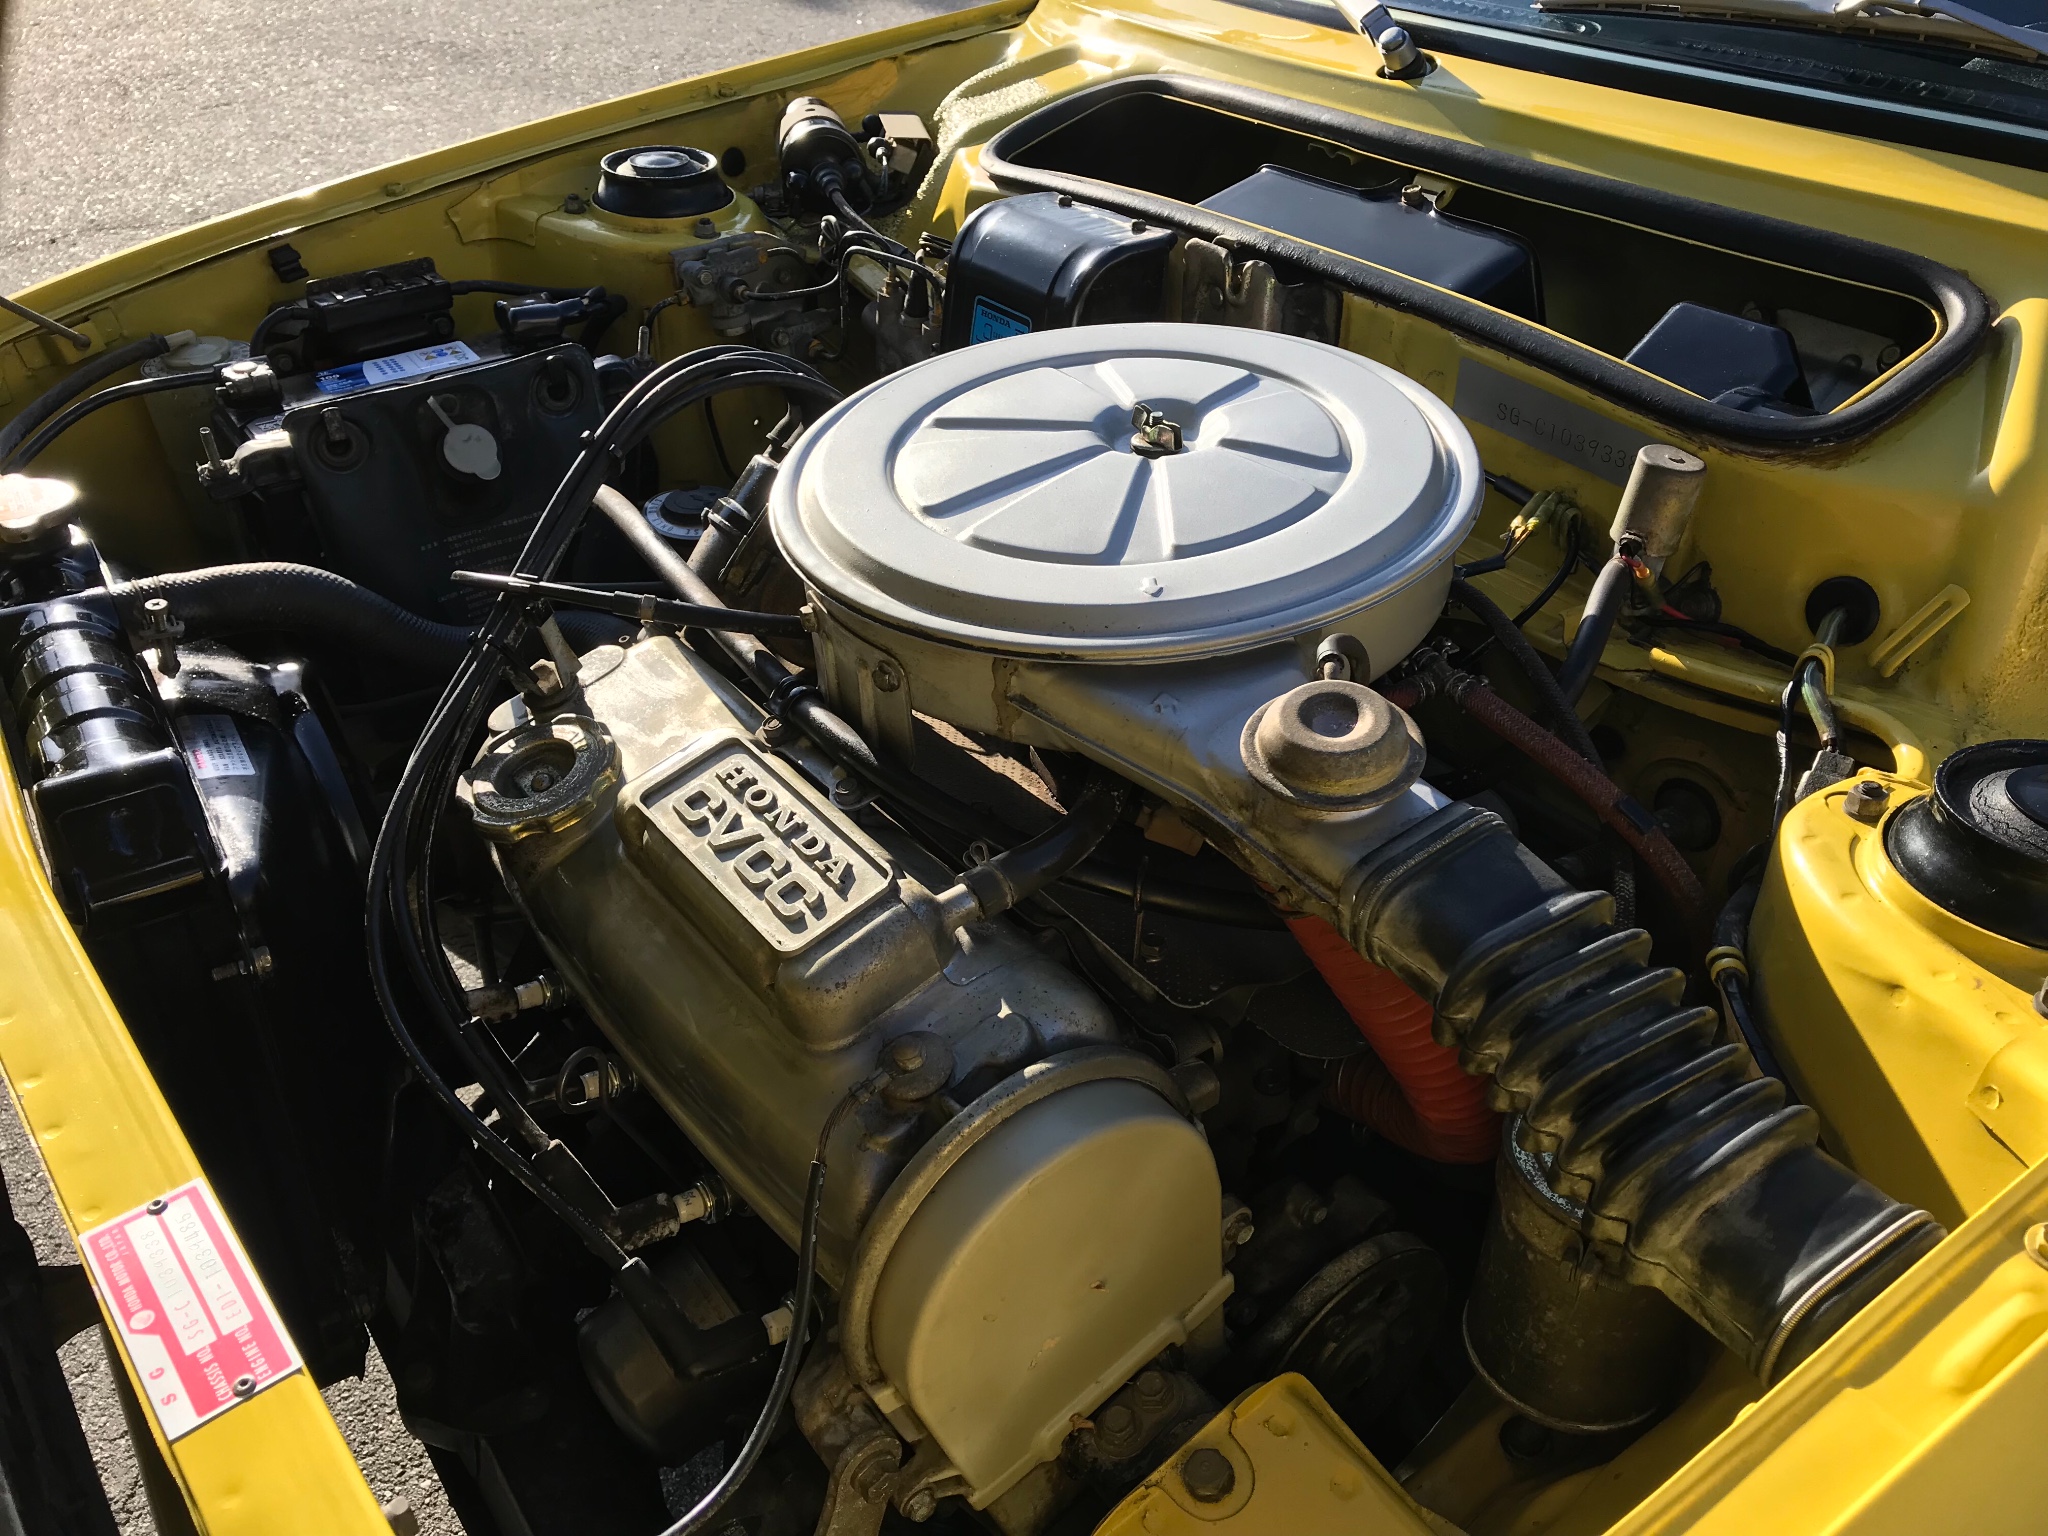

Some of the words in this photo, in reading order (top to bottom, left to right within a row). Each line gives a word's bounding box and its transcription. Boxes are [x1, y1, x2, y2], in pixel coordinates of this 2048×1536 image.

[981, 309, 1011, 328] HONDA
[715, 759, 849, 887] HONDA
[672, 783, 821, 920] CVCC
[108, 1258, 131, 1287] MOTOR
[120, 1283, 143, 1313] HONDA
[233, 1323, 253, 1343] NO.
[194, 1344, 215, 1364] NO.
[241, 1340, 272, 1380] ENGINE
[203, 1361, 233, 1401] CHASSIS
